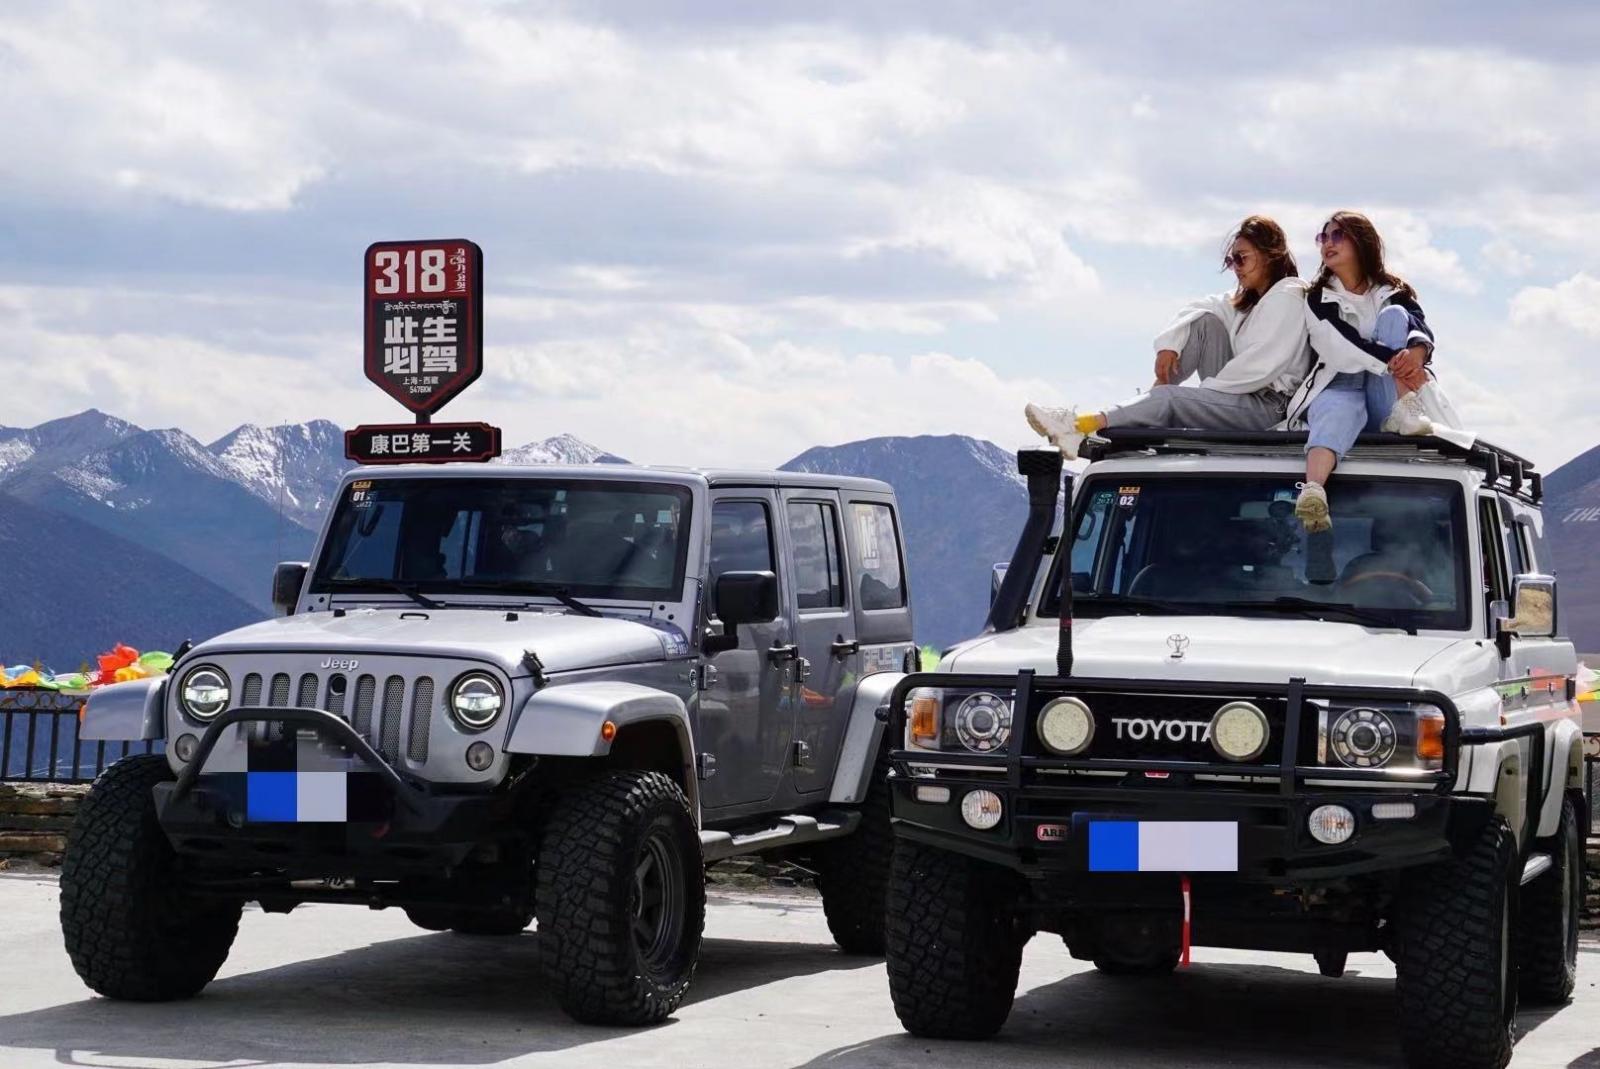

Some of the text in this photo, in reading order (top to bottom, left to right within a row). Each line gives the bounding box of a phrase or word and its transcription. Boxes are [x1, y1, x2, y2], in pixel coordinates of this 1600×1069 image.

[375, 249, 446, 294] 318
[384, 316, 457, 344] 此生
[383, 345, 457, 374] 必驾
[370, 432, 472, 455] 康巴第一关
[353, 491, 366, 502] 01
[1119, 495, 1135, 506] 02
[320, 656, 359, 672] Jeep
